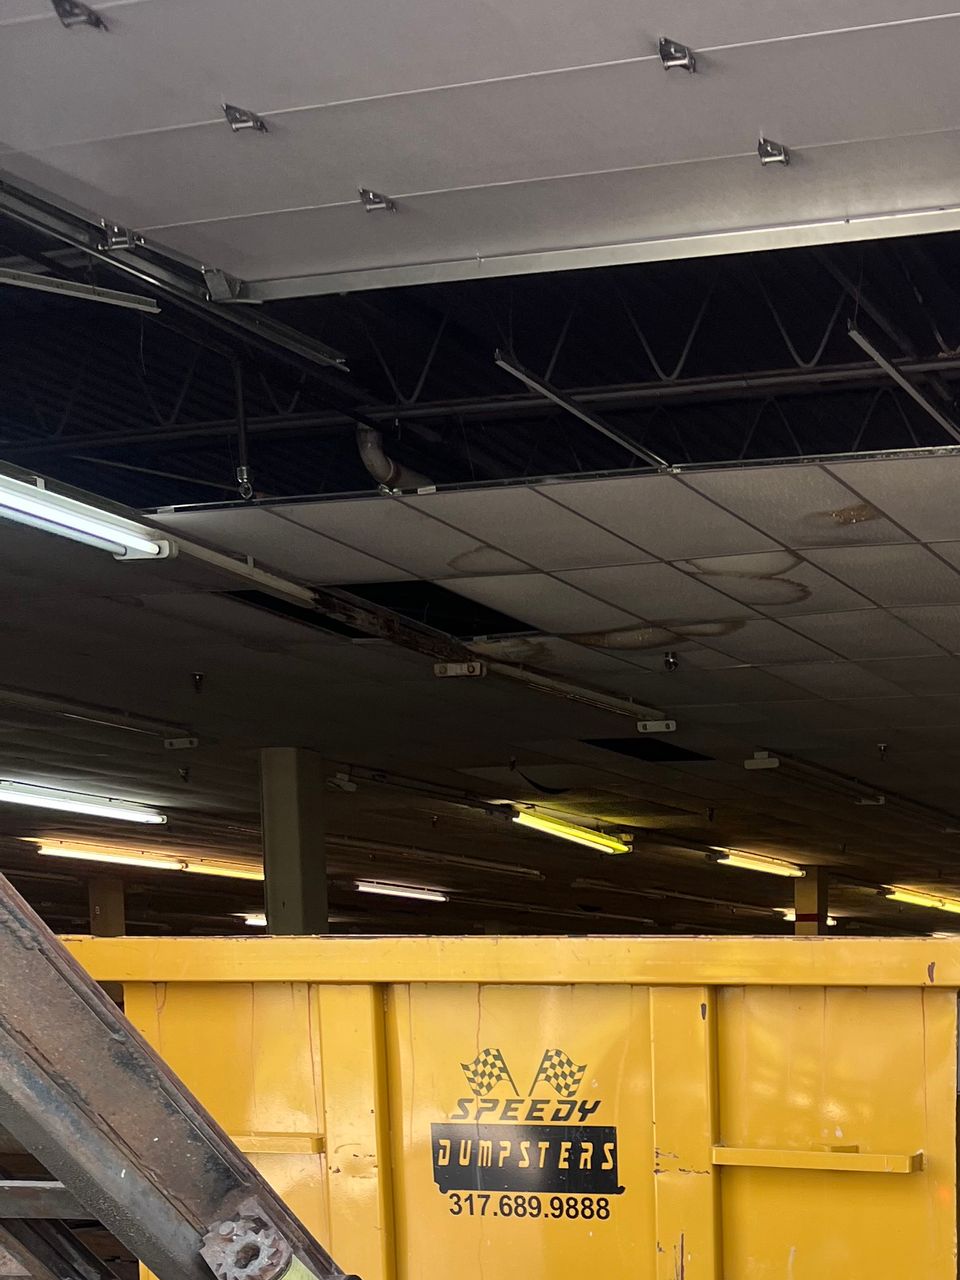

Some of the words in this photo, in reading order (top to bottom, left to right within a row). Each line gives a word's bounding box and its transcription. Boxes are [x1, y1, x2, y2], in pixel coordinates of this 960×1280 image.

[451, 1098, 602, 1122] SPEEDY
[437, 1138, 615, 1170] DUMPSTERS
[449, 1193, 611, 1220] 317.689.9888
